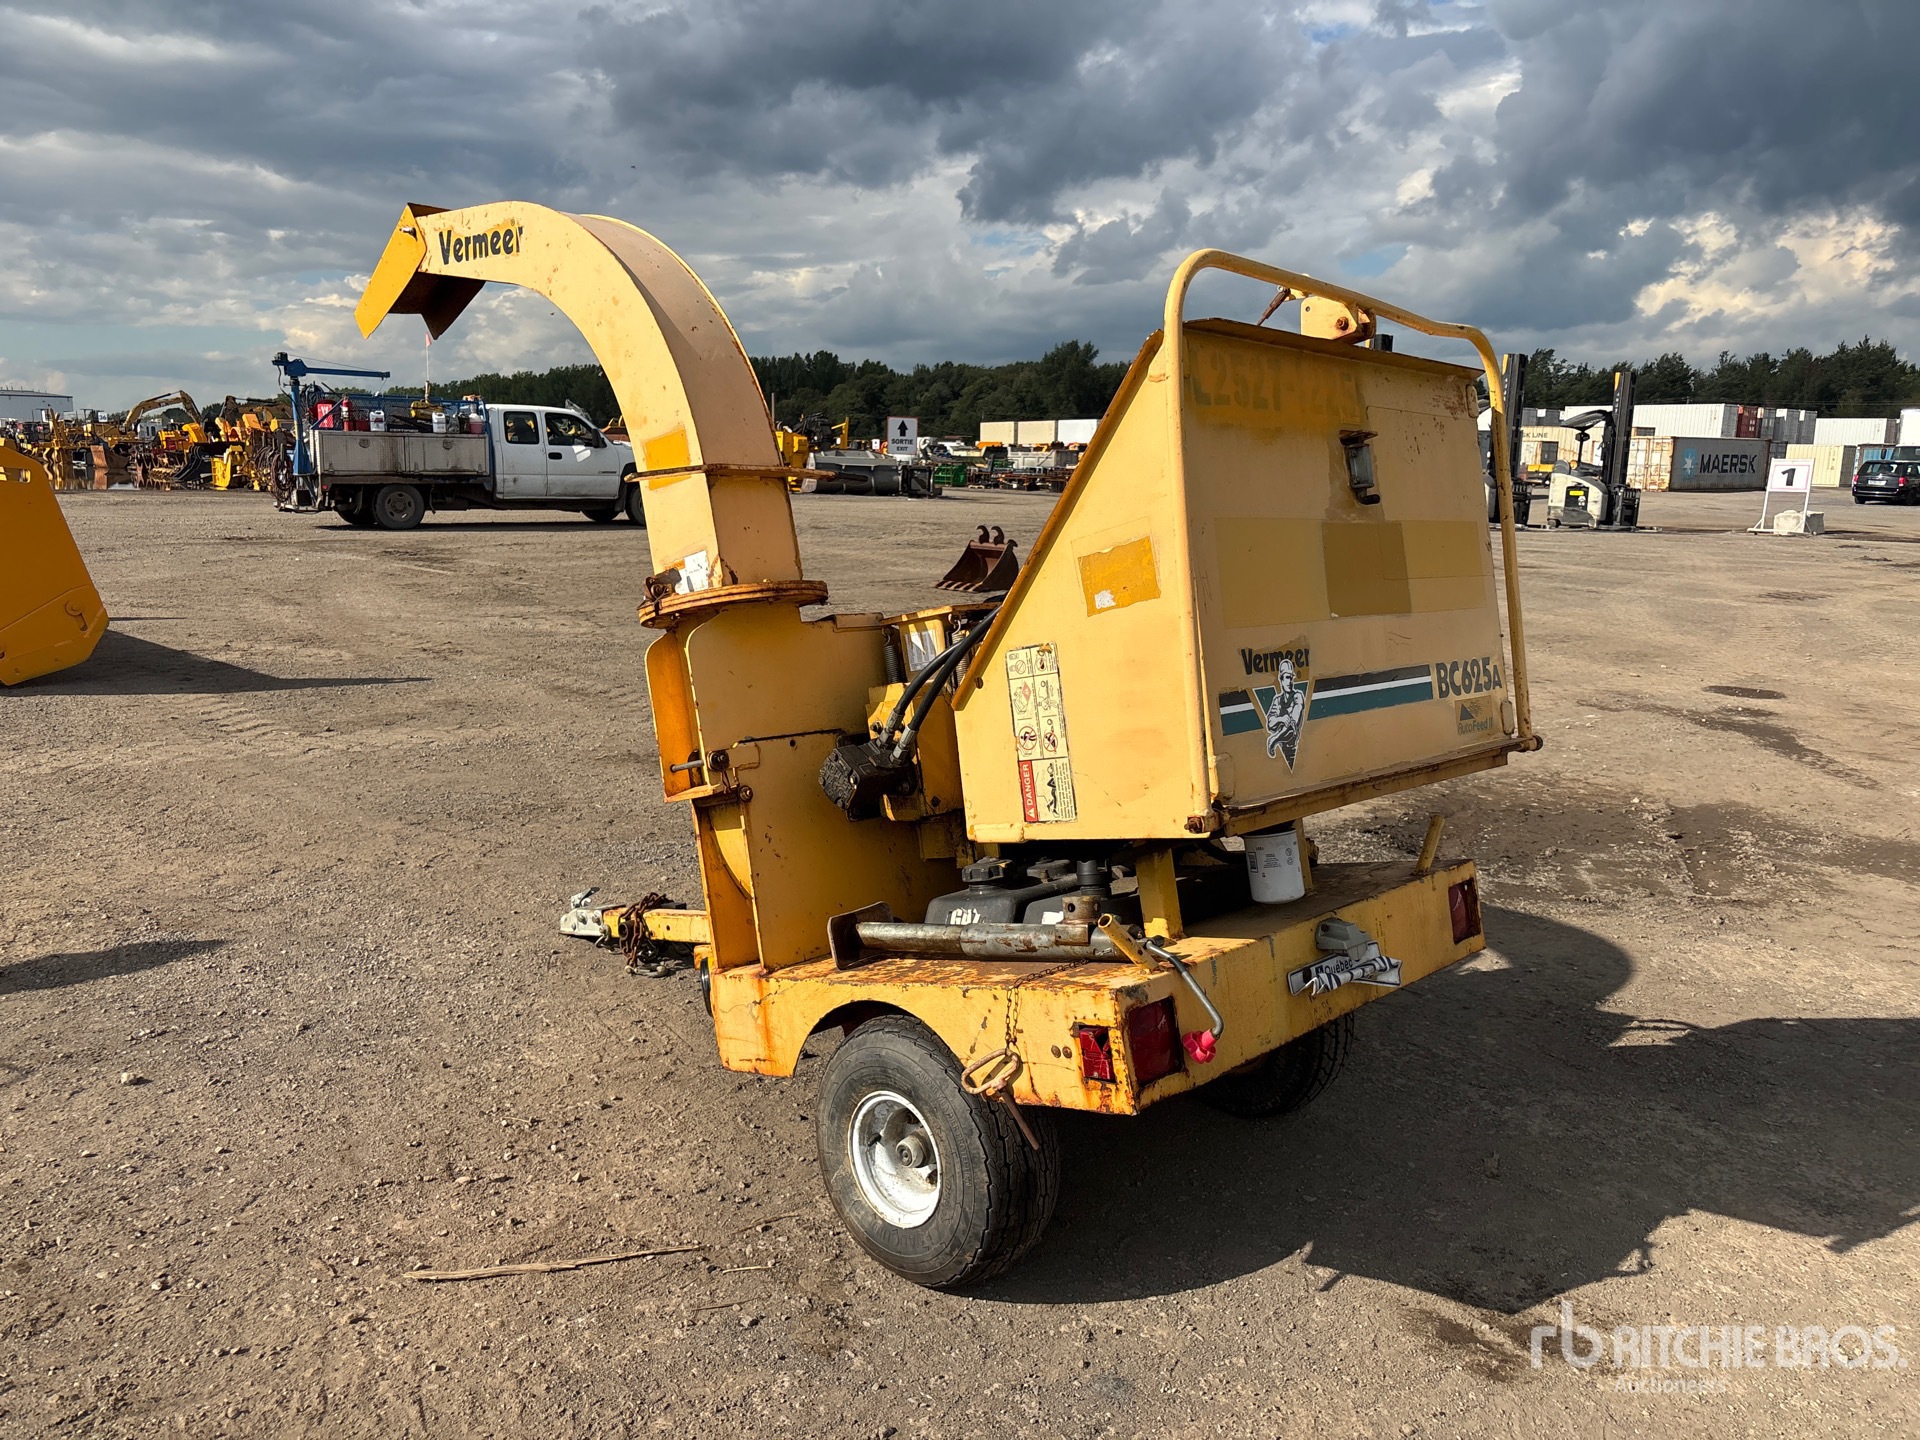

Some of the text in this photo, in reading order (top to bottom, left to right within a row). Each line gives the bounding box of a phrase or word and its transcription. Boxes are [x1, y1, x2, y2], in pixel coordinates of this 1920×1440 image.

[438, 225, 523, 265] Vermeer
[1700, 453, 1757, 474] MAERSK
[1781, 468, 1797, 487] 1
[1240, 648, 1310, 676] Vermeer
[1435, 656, 1503, 699] BC625A
[1457, 717, 1488, 736] AutoFeed
[1022, 763, 1034, 806] DANGER
[1324, 960, 1354, 975] Québec
